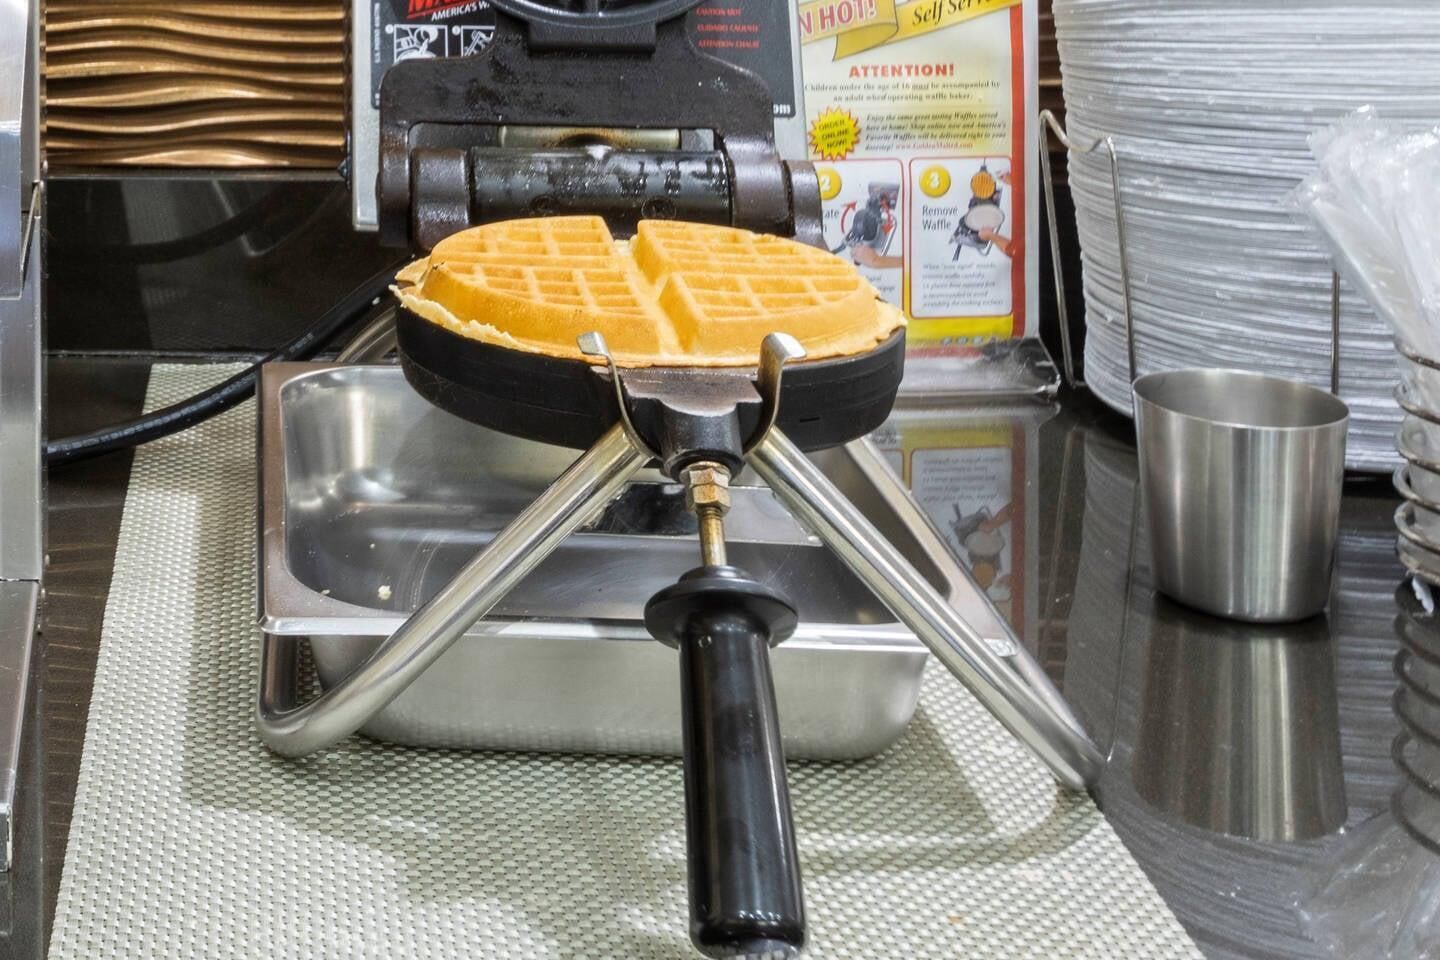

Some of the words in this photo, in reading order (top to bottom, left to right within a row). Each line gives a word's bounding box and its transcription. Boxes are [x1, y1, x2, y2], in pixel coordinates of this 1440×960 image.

[431, 3, 477, 21] AMERICA'S
[912, 0, 947, 26] Self
[849, 63, 955, 78] ATTENTION!
[863, 82, 875, 90] the
[821, 175, 831, 188] 2
[929, 174, 940, 188] 3
[922, 204, 959, 217] Remove
[922, 219, 952, 231] Waffle
